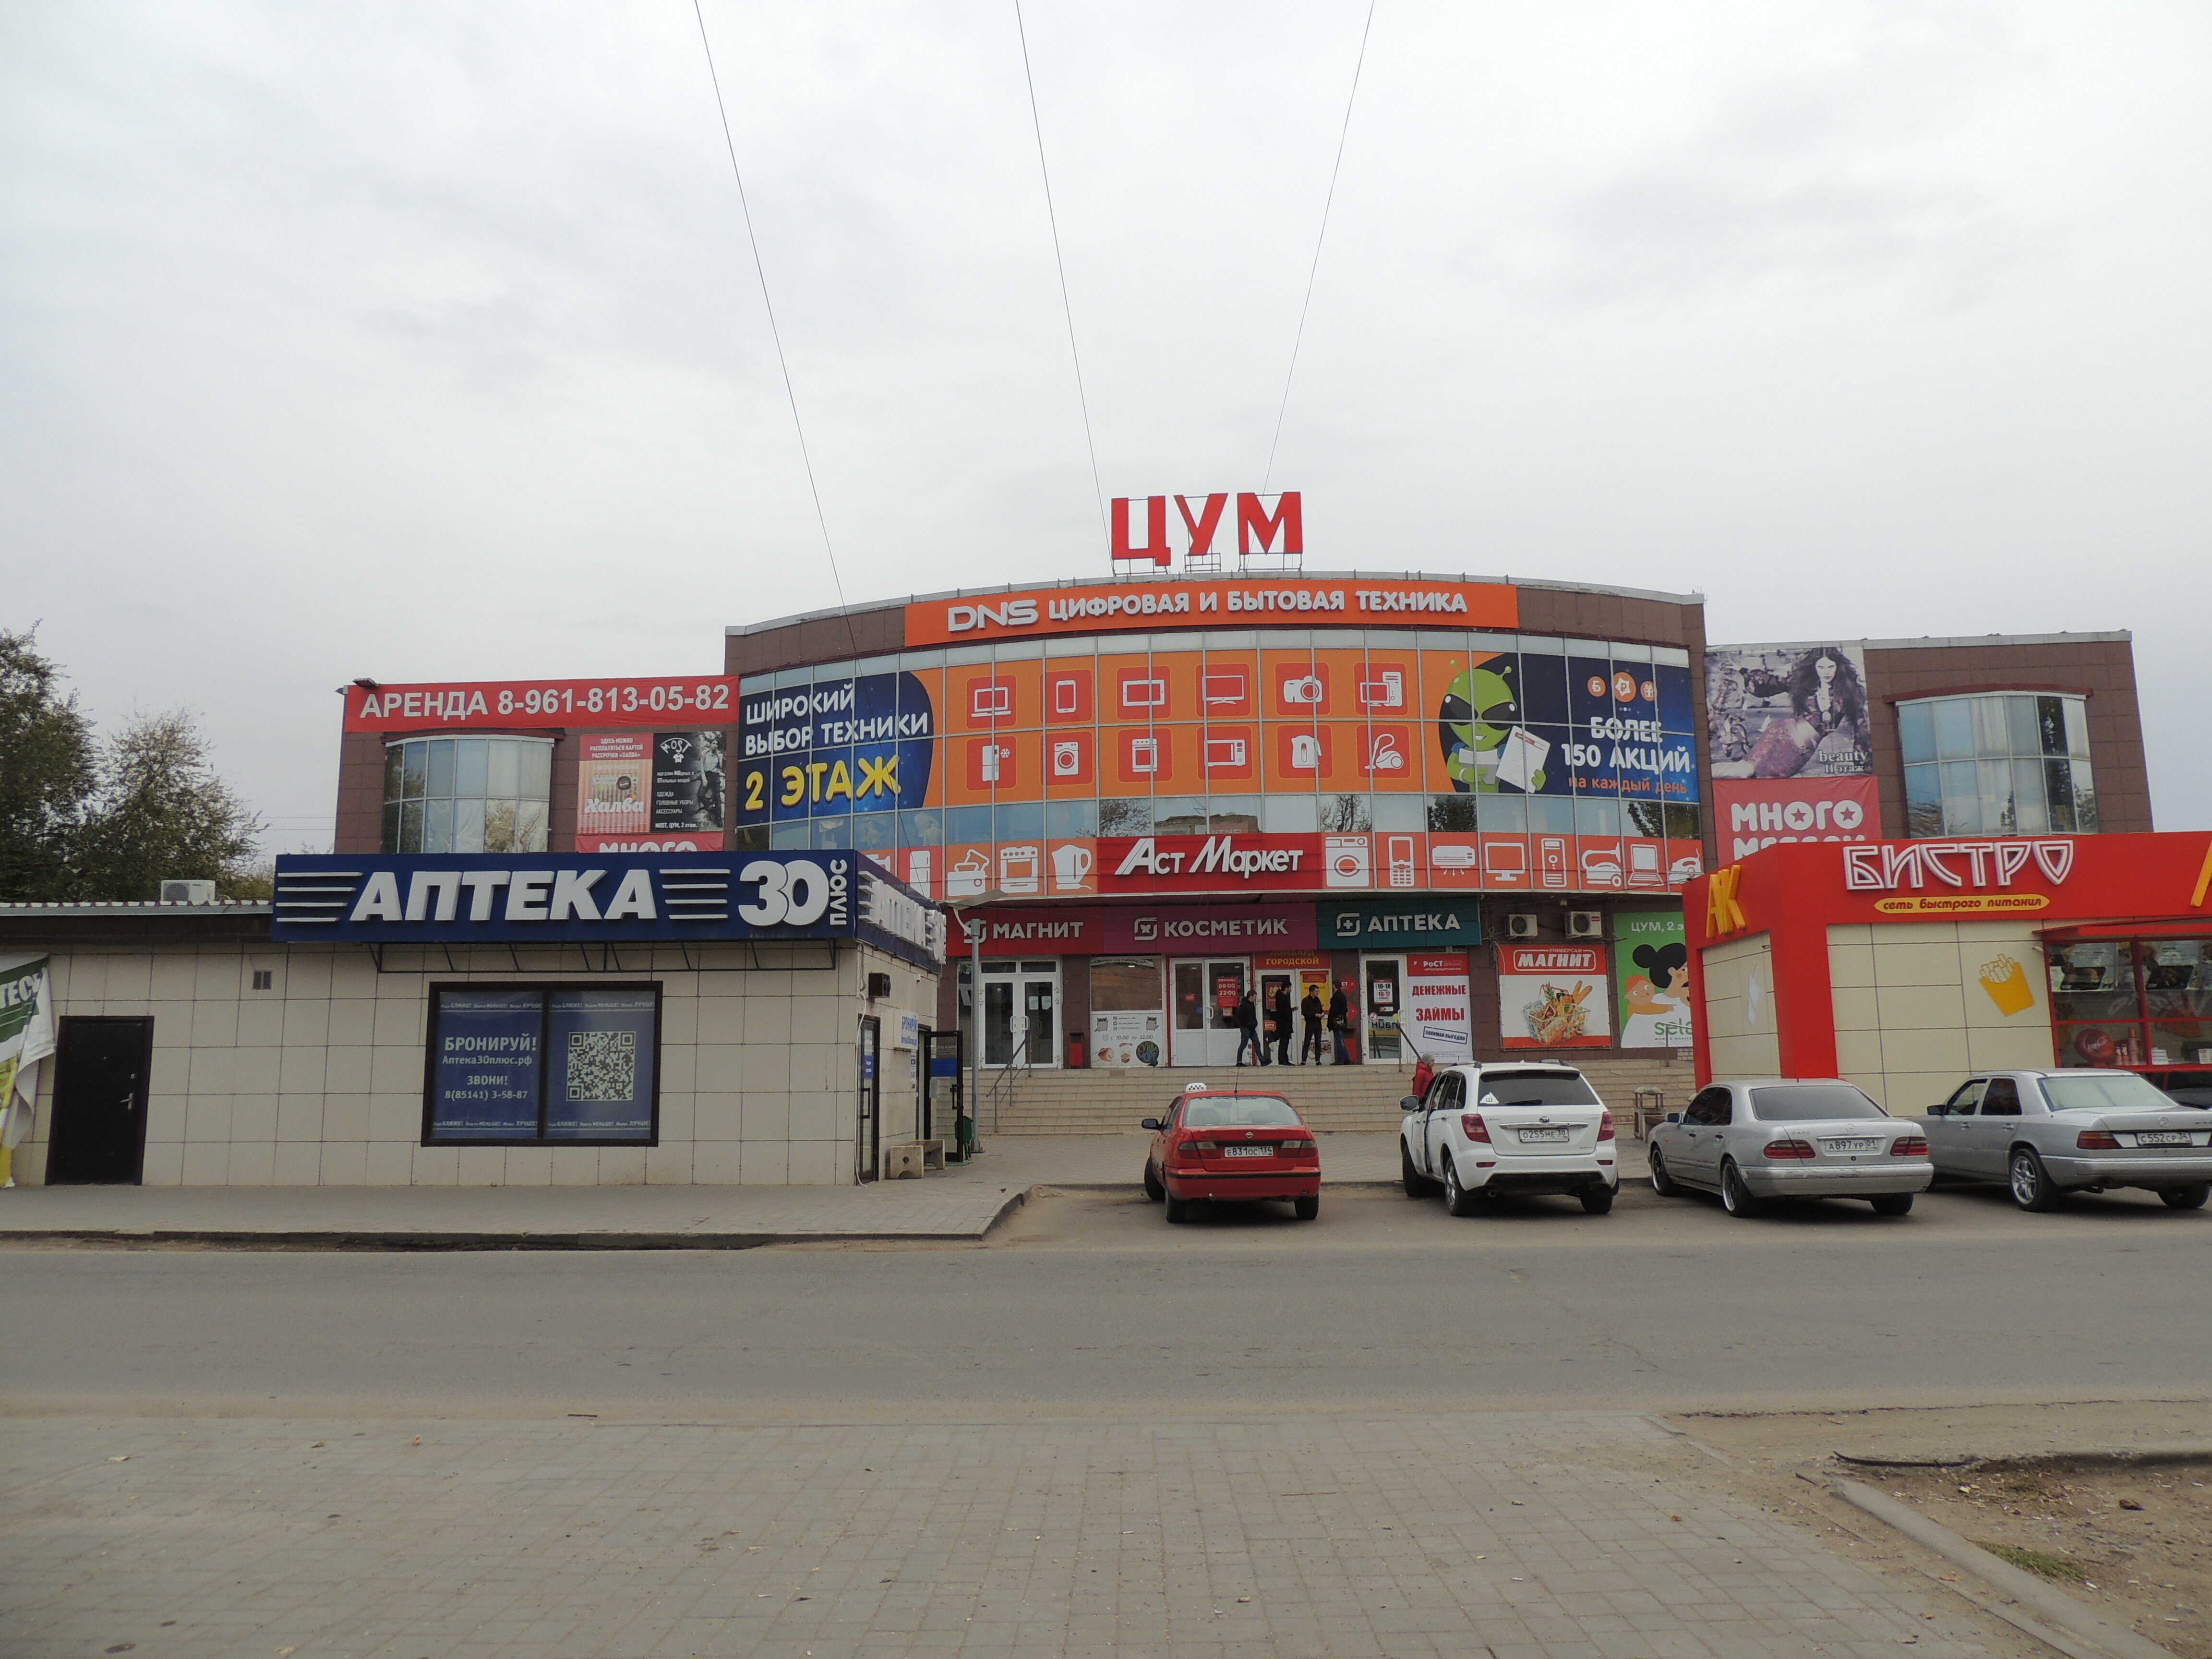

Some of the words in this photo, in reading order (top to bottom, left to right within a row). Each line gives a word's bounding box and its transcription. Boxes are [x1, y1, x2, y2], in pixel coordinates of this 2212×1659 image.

[1111, 492, 1303, 567] ЦУМ
[948, 599, 1039, 632] DNS
[1049, 592, 1190, 622] ЦИФРОВАЯ
[1200, 592, 1217, 612] И
[1227, 590, 1344, 612] БЫТОВАЯ
[1355, 590, 1467, 613] ТЕХНИКА
[360, 690, 489, 721] АРЕНДА
[497, 685, 729, 715] 8-961-813-05-82
[746, 683, 854, 725] ШИРОКИЙ
[745, 725, 813, 756] ВЫБОР
[821, 712, 928, 745] ТЕХНИКИ
[1590, 716, 1663, 743] БОЛЕЕ
[660, 738, 692, 754] MOST
[1561, 743, 1601, 768] 150
[1609, 745, 1691, 775] АКЦИЙ
[1818, 750, 1868, 764] beauty
[745, 770, 764, 811] 2
[781, 754, 902, 806] ЭТАЖ
[1568, 776, 1587, 789] на
[1592, 777, 1650, 792] каждый
[1655, 778, 1687, 794] день
[584, 797, 644, 813] Халва
[1731, 799, 1863, 832] МНОГО
[1114, 838, 1185, 875] Аст
[1189, 836, 1303, 879] Маркет
[1843, 840, 2074, 890] БИСТРО
[349, 870, 658, 921] АПТЕКА
[738, 860, 830, 926] 30
[830, 859, 847, 926] ПЛЮС
[1883, 902, 1913, 910] сеть
[1919, 899, 1981, 911] быстрого
[1987, 898, 2041, 907] питания
[993, 922, 1083, 939] МАГНИТ
[1165, 918, 1288, 938] КОСМЕТИК
[1368, 914, 1461, 932] АПТЕКА
[1631, 922, 1664, 932] ЦУМ,
[1667, 921, 1674, 930] 2
[1266, 956, 1319, 966] ГОРОДСКОЙ
[1517, 954, 1591, 967] МАГНИТ
[1412, 985, 1466, 997] ДЕНЕЖНЫЕ
[1416, 1006, 1465, 1022] ЗАЙМЫ
[445, 1033, 537, 1051] БРОНИРУЙ!
[442, 1055, 532, 1066] Аптека30плюс.рф
[467, 1075, 508, 1085] ЗВОНИ!
[445, 1090, 489, 1101] 8(85141)
[492, 1091, 528, 1099] 3-58-87
